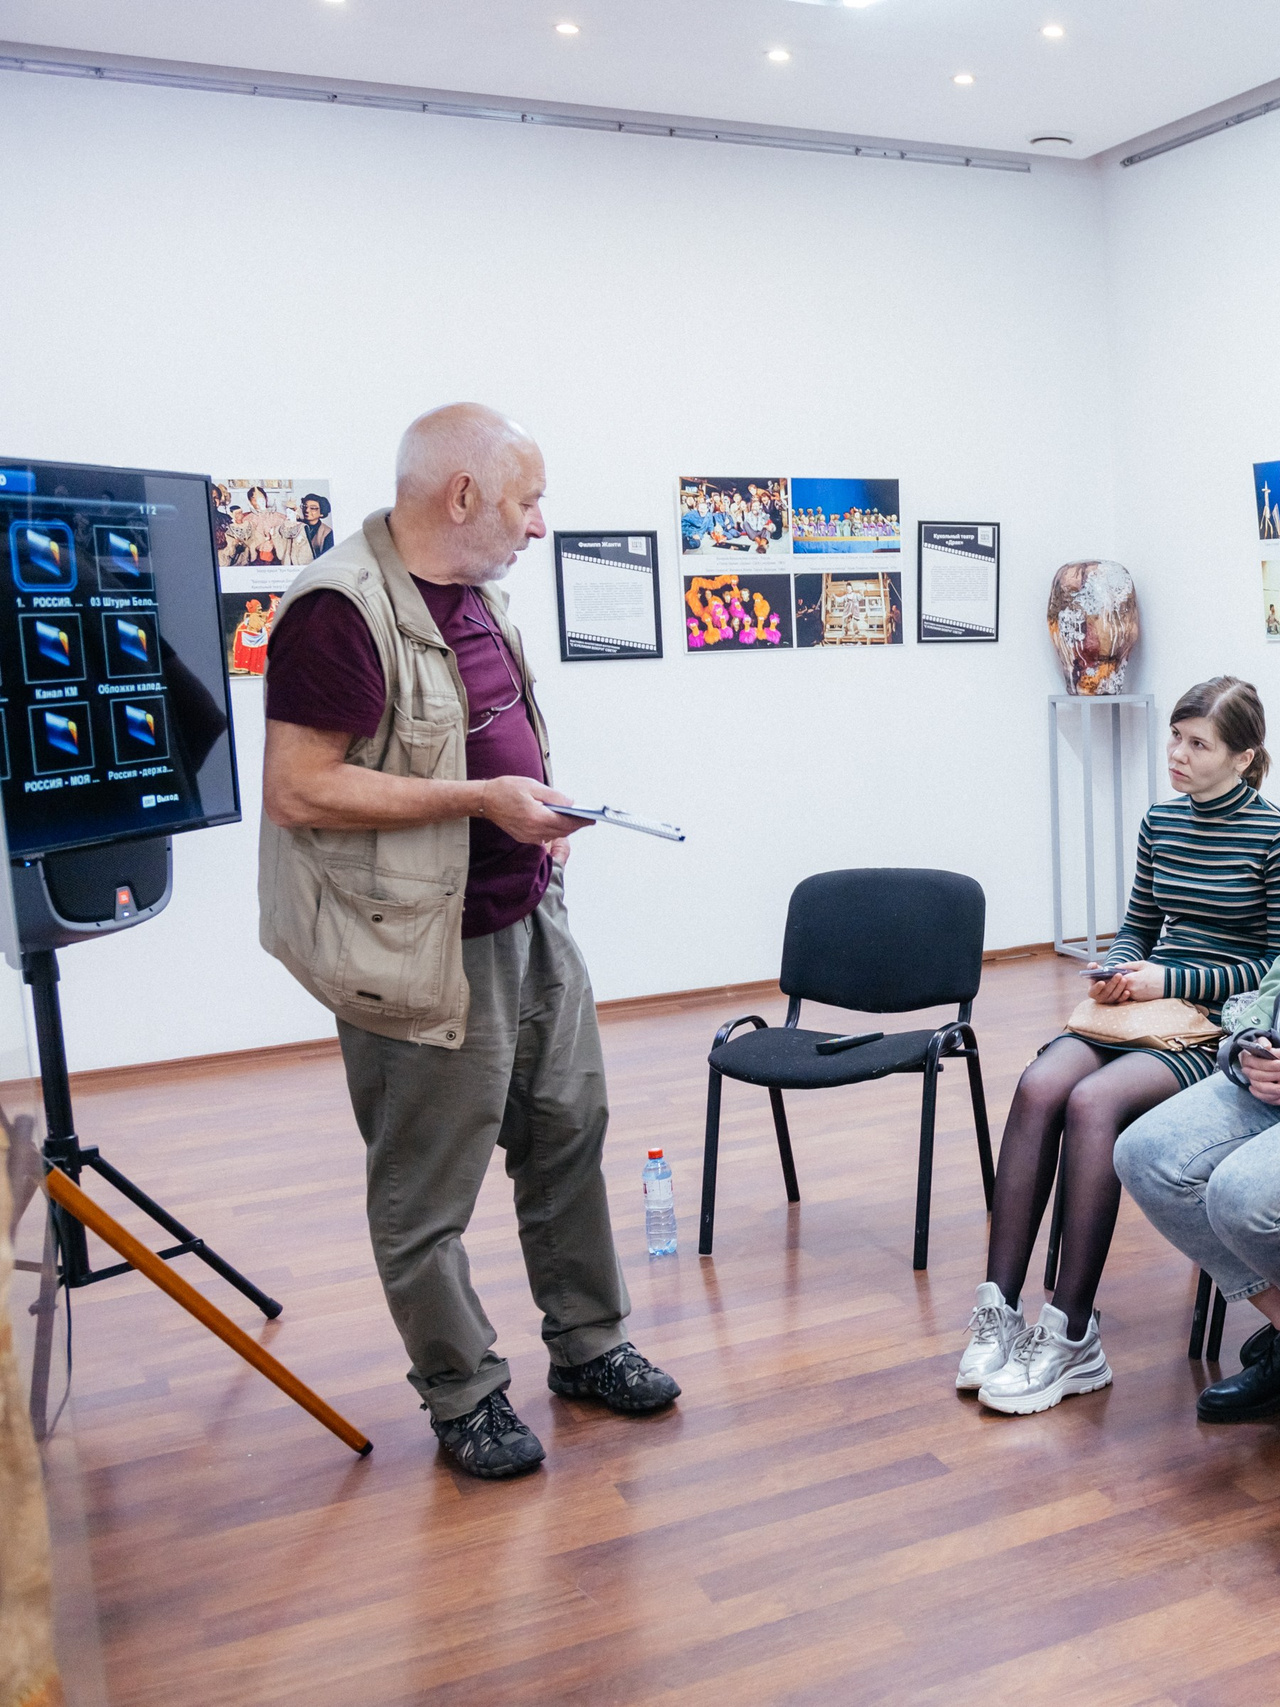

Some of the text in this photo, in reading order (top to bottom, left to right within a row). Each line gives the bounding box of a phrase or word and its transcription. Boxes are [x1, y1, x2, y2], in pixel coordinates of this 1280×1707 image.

[102, 597, 131, 609] Штурм
[35, 689, 63, 699] Канал
[108, 770, 138, 781] Россия
[24, 777, 63, 793] РОССИЯ
[70, 774, 91, 787] МОЯ
